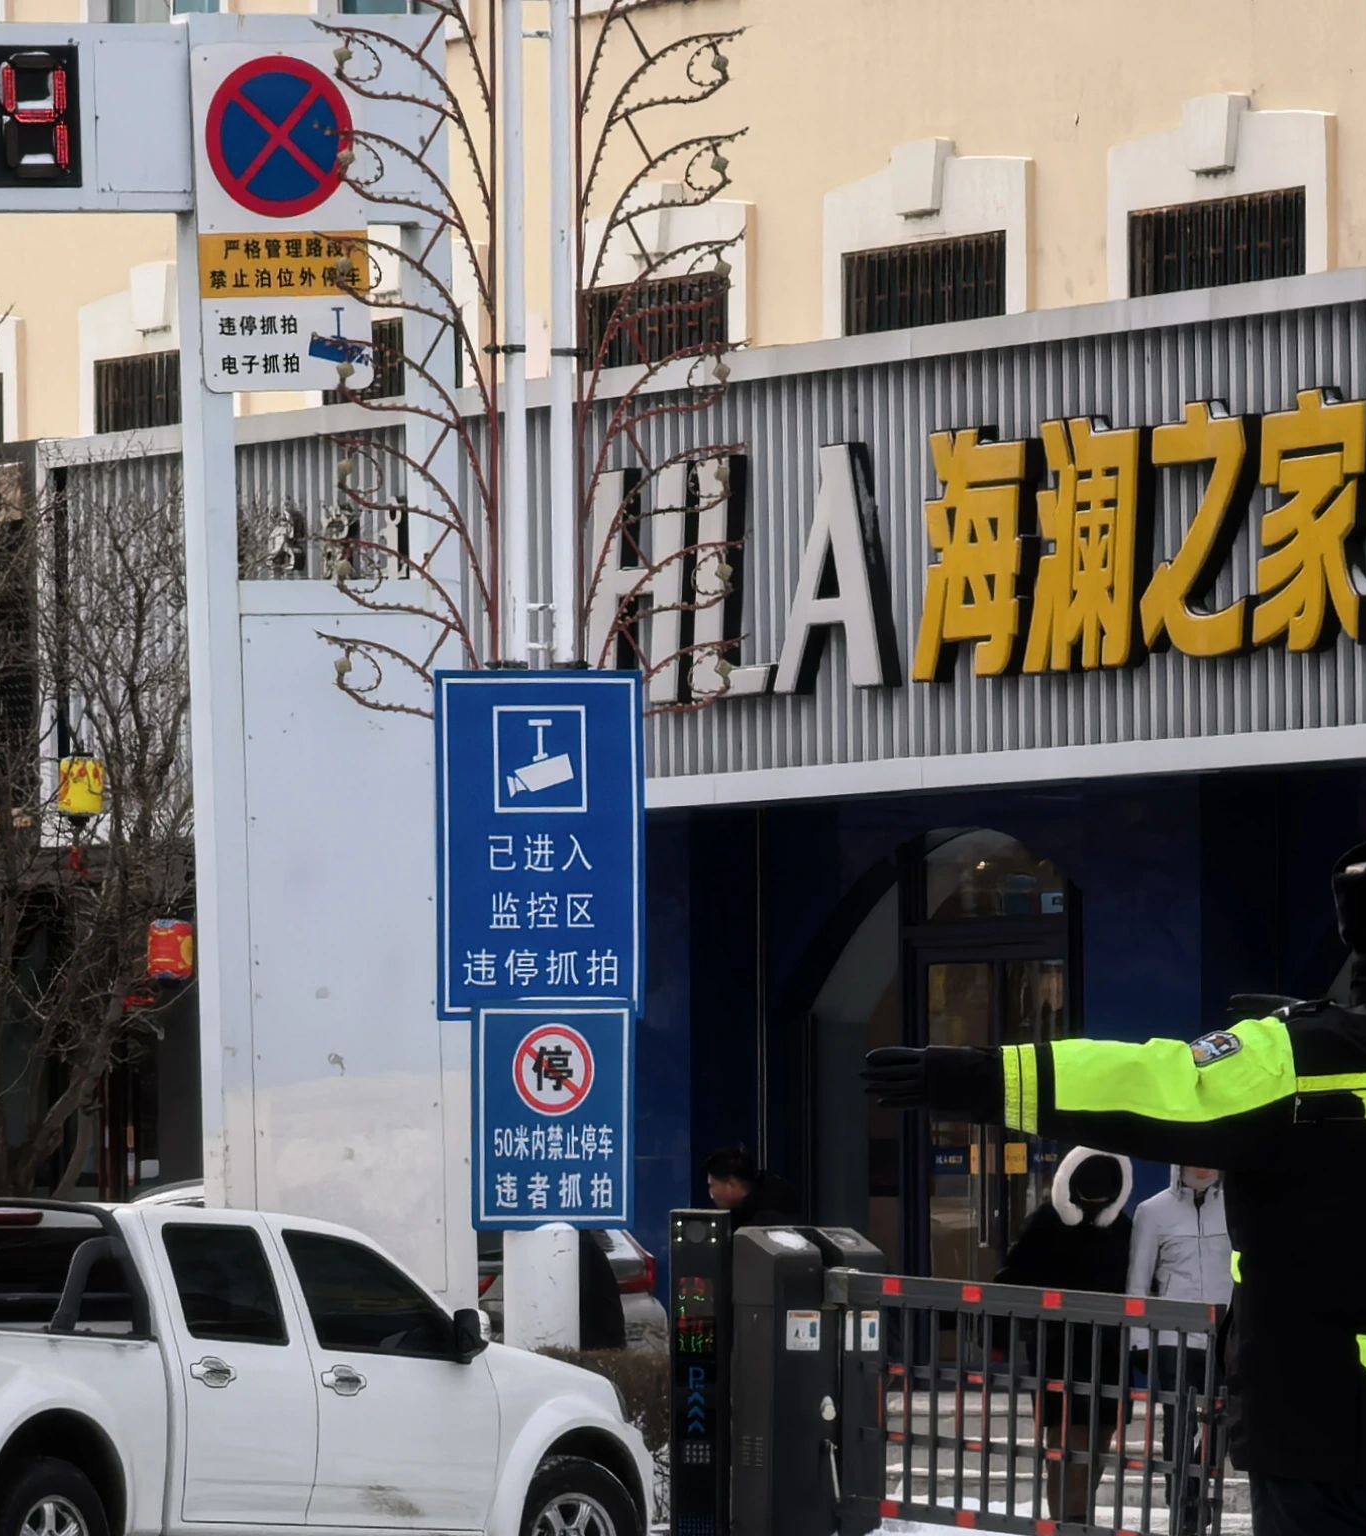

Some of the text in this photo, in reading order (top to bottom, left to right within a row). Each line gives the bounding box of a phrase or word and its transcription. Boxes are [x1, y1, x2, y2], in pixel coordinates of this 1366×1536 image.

[223, 238, 344, 260] 严格管理路段
[219, 315, 298, 336] 违停抓拍
[221, 353, 300, 375] 电子抓拍
[588, 442, 891, 704] HLA
[488, 834, 593, 872] 已进入
[489, 892, 595, 929] 监控区
[463, 948, 618, 987] 违停抓拍
[532, 1045, 574, 1091] 停
[494, 1124, 613, 1160] 50米内禁止停车
[495, 1172, 613, 1209] 违者抓拍
